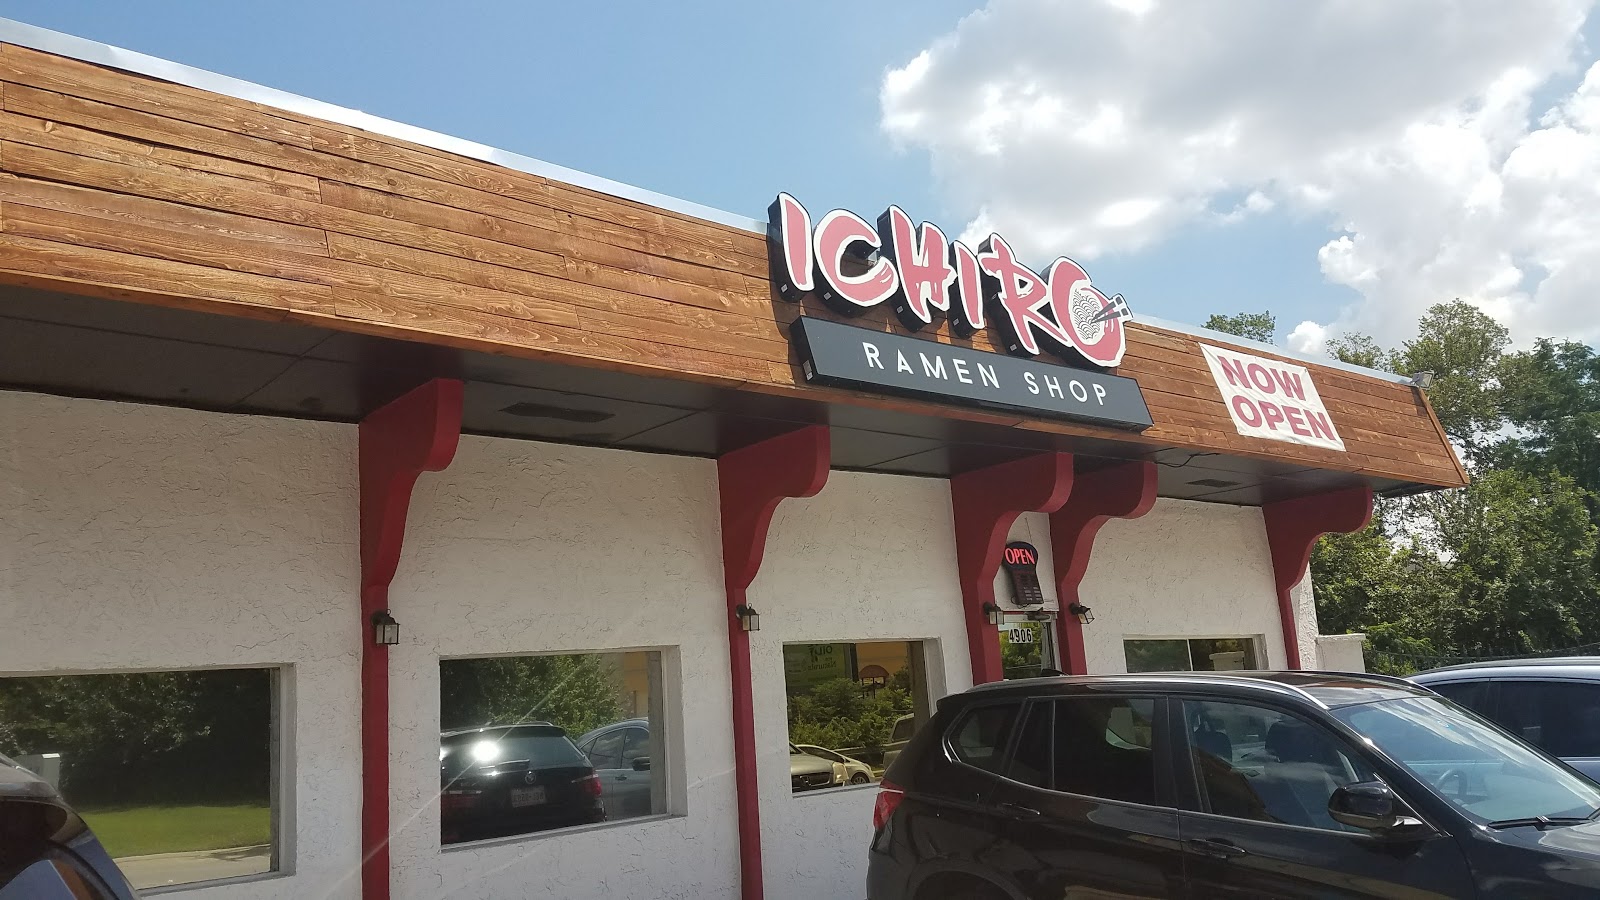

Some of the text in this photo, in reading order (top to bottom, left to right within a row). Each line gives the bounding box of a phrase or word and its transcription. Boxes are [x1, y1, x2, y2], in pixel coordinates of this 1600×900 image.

[778, 191, 1129, 367] ICHIRO
[862, 342, 1106, 405] RAMEN SHOP
[1217, 355, 1306, 401] NOW
[1231, 395, 1335, 441] OPEN
[1005, 547, 1035, 565] OPEN
[1009, 628, 1032, 643] 4906
